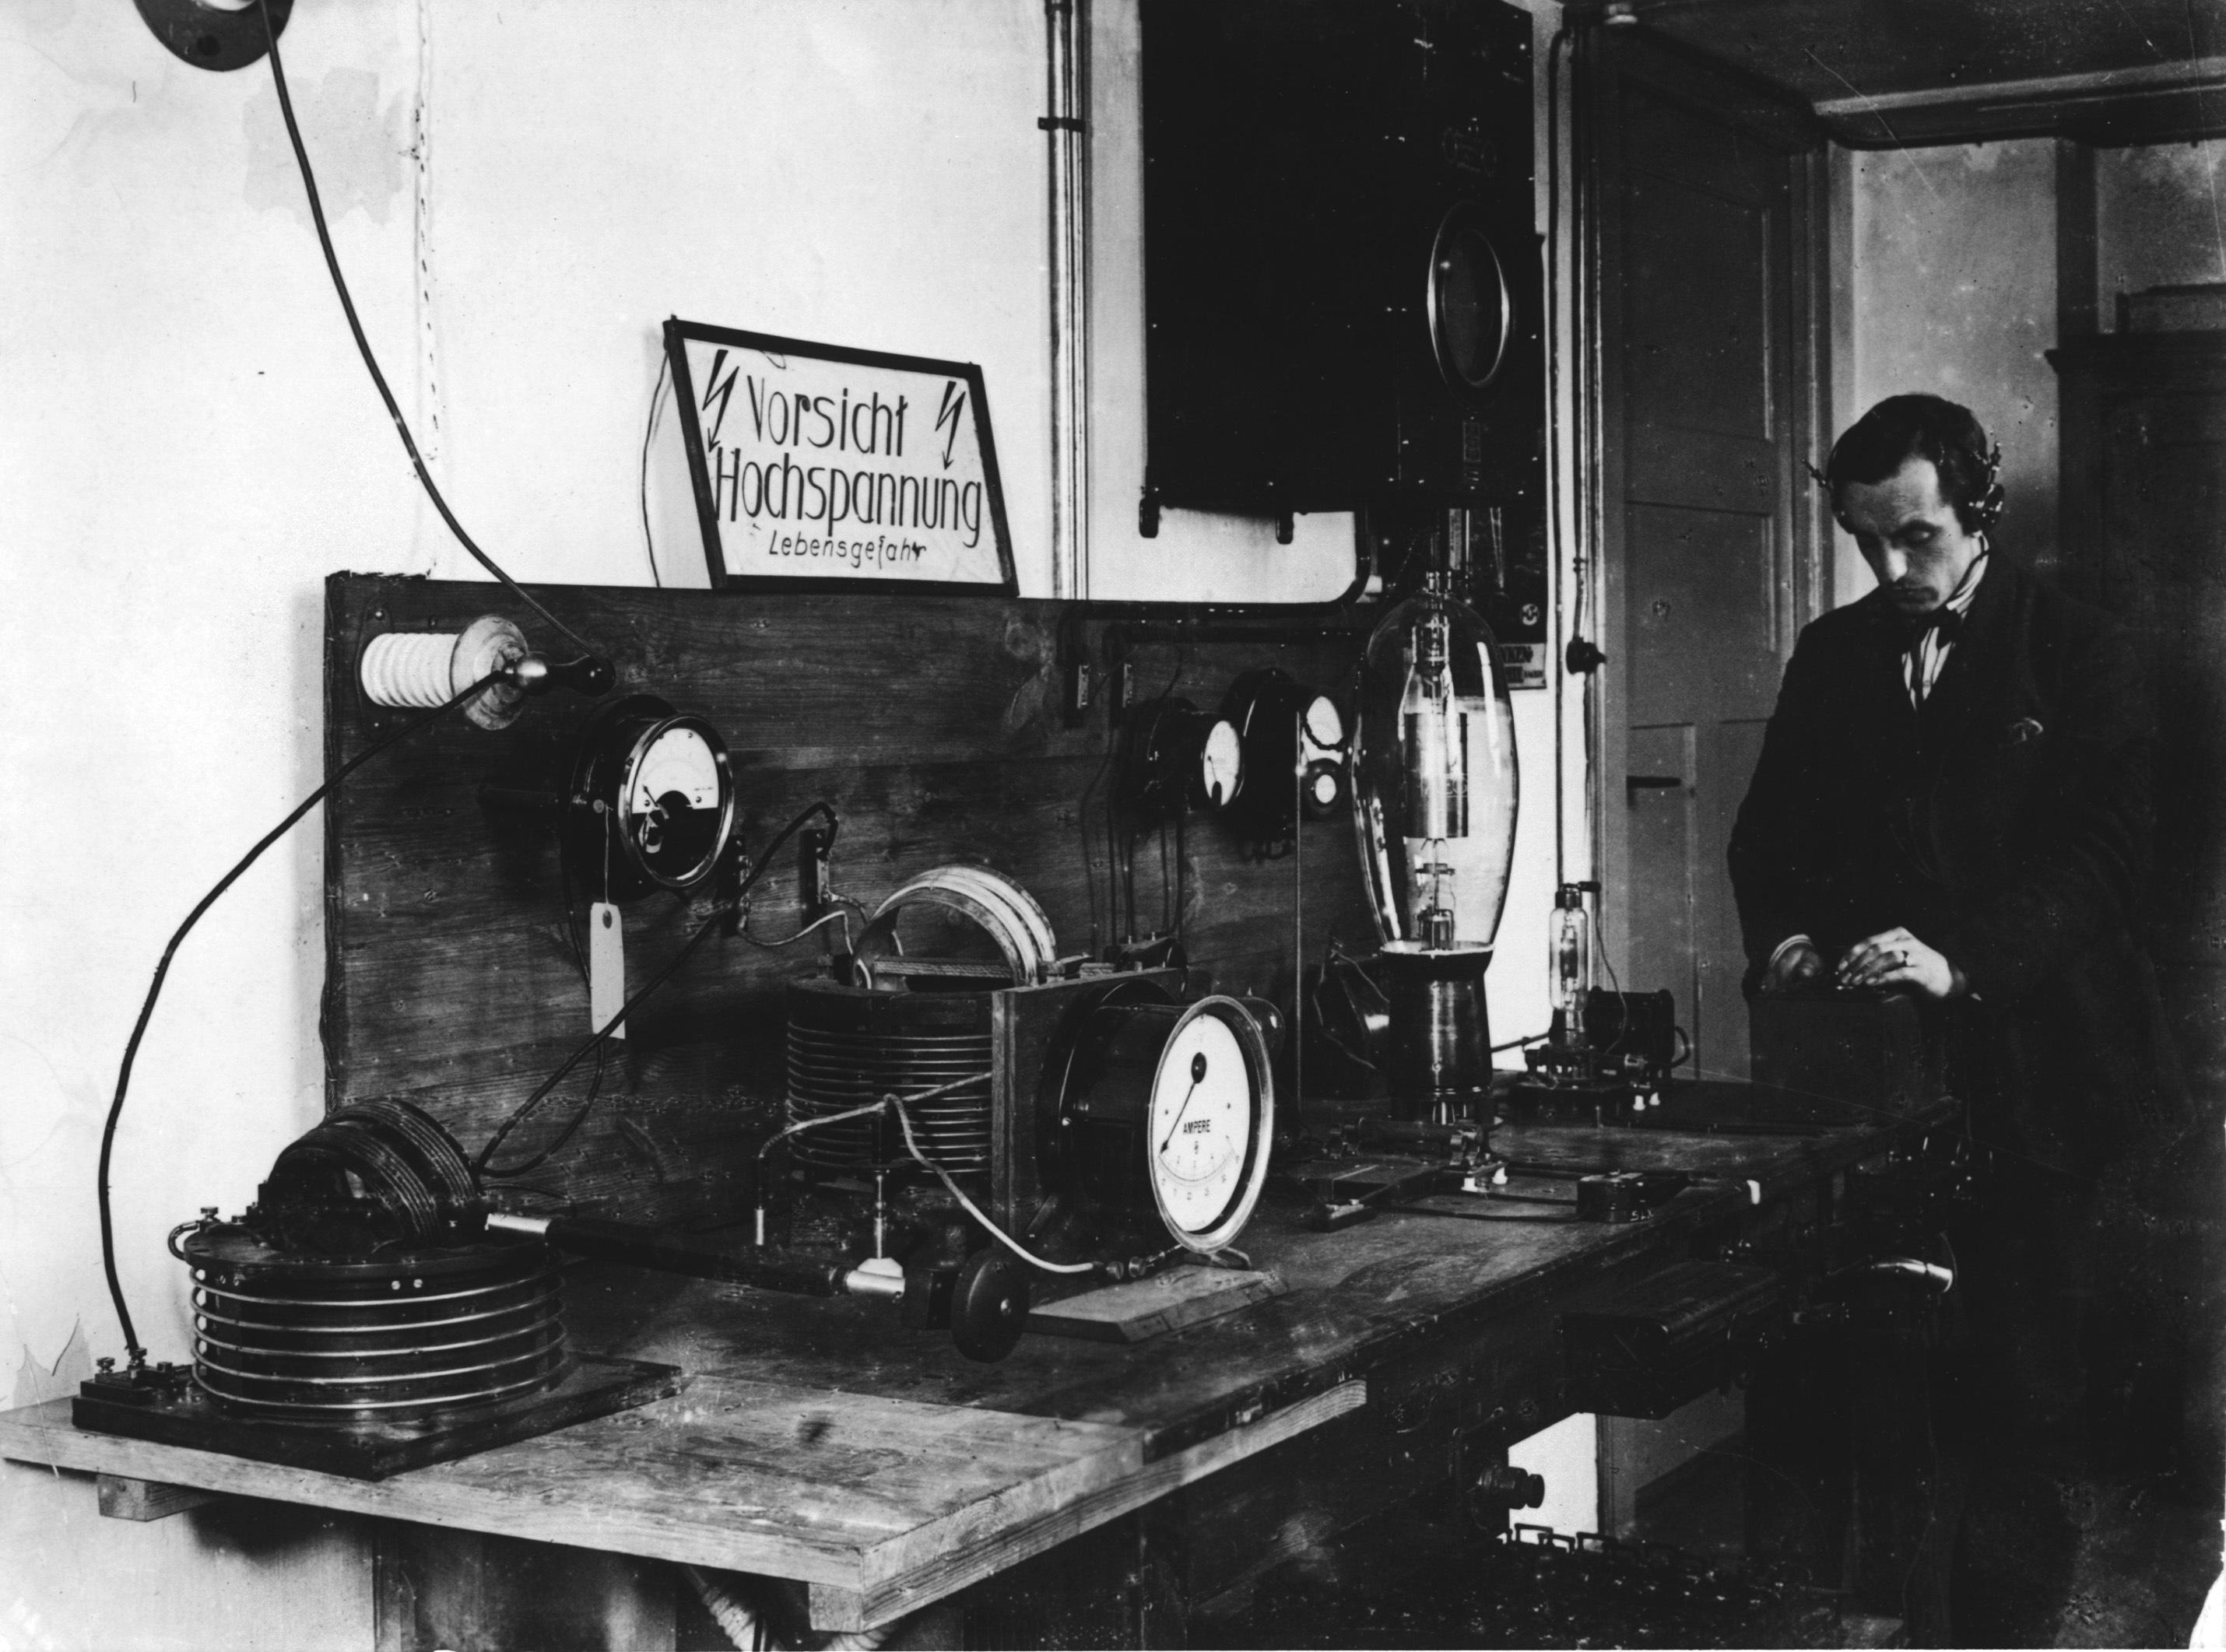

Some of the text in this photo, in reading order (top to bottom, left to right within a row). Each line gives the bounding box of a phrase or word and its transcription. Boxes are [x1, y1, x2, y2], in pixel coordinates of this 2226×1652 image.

[746, 374, 908, 457] Vorsicht
[715, 446, 982, 549] Hochspannung
[768, 529, 927, 570] Lebensgefahr
[1182, 1119, 1211, 1134] AMPERE
